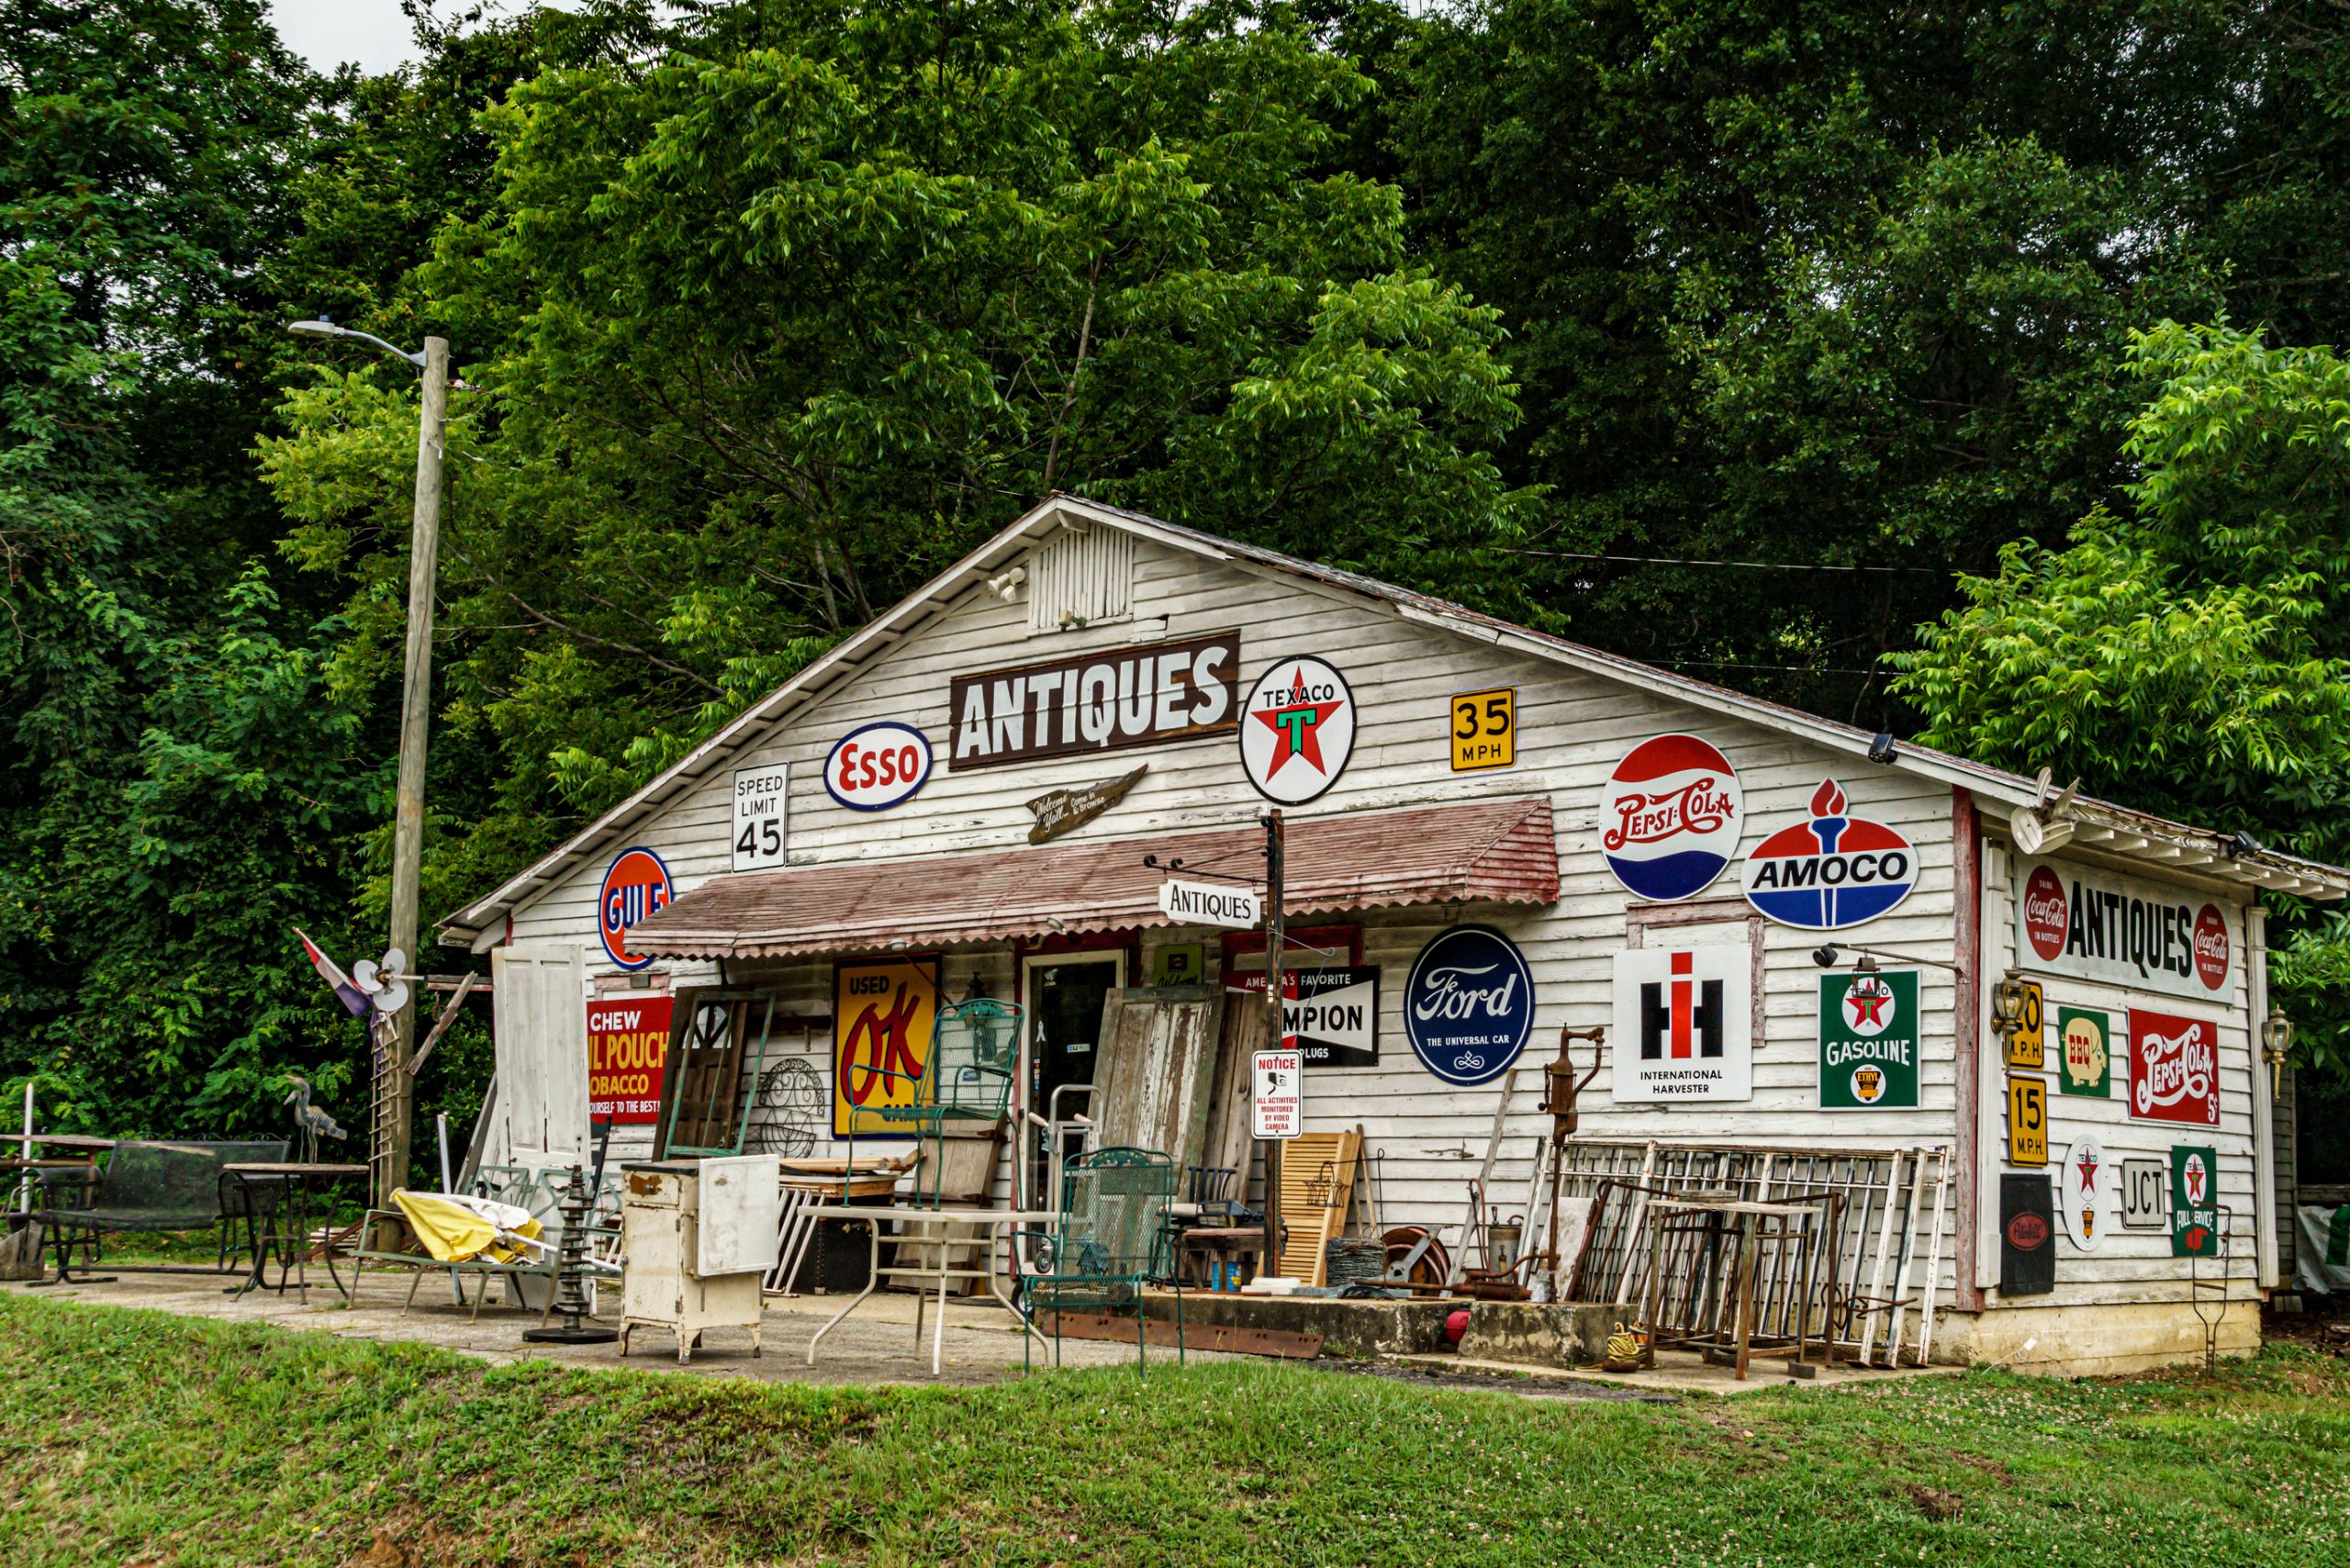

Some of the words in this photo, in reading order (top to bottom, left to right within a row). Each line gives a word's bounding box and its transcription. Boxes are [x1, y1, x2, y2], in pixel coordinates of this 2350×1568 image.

[957, 646, 1229, 759] ANTIQUES
[1263, 684, 1334, 708] TEXACO
[1455, 698, 1509, 739] 35
[1277, 709, 1317, 755] T
[1462, 743, 1501, 761] MPH
[737, 776, 783, 796] SPEED
[741, 797, 777, 817] LIMIT
[1034, 793, 1068, 817] Welcome
[1070, 795, 1088, 807] Come
[1089, 790, 1095, 801] in
[1073, 807, 1080, 815] &
[1080, 796, 1105, 812] Browse
[735, 818, 780, 858] 45
[1751, 852, 1908, 889] AMOCO
[1170, 884, 1251, 921] ANTIQUES
[2034, 931, 2040, 940] IN
[2041, 932, 2059, 944] BOTTLES
[2066, 880, 2192, 979] ANTIQUES
[850, 975, 890, 995] USED
[1301, 973, 1350, 986] FAVORITE
[1416, 963, 1517, 1020] Ford
[1861, 1001, 1876, 1018] T
[590, 1011, 641, 1031] CHEW
[606, 1032, 671, 1070] POUCH
[840, 981, 927, 1107] OK
[1427, 1037, 1442, 1047] THE
[1446, 1036, 1489, 1046] UNIVERSAL
[1493, 1035, 1509, 1044] CAR
[1826, 1039, 1910, 1066] GASOLINE
[2069, 1034, 2090, 1070] BBQ
[1259, 1058, 1296, 1070] NOTICE
[589, 1074, 649, 1095] OBACCO
[1640, 1070, 1722, 1081] INTERNATIONAL
[1857, 1072, 1879, 1081] ETHYL
[1653, 1083, 1709, 1094] HARVESTER
[588, 1102, 614, 1114] OURSELF
[616, 1101, 624, 1113] TO
[626, 1101, 638, 1113] THE
[640, 1101, 661, 1113] BEST!
[2016, 1087, 2041, 1130] 15
[2017, 1137, 2043, 1155] M.P.H.
[2078, 1154, 2098, 1163] TEXACO
[2187, 1162, 2203, 1171] TEXACO
[2128, 1170, 2162, 1215] JCT
[2177, 1210, 2191, 1232] FULL
